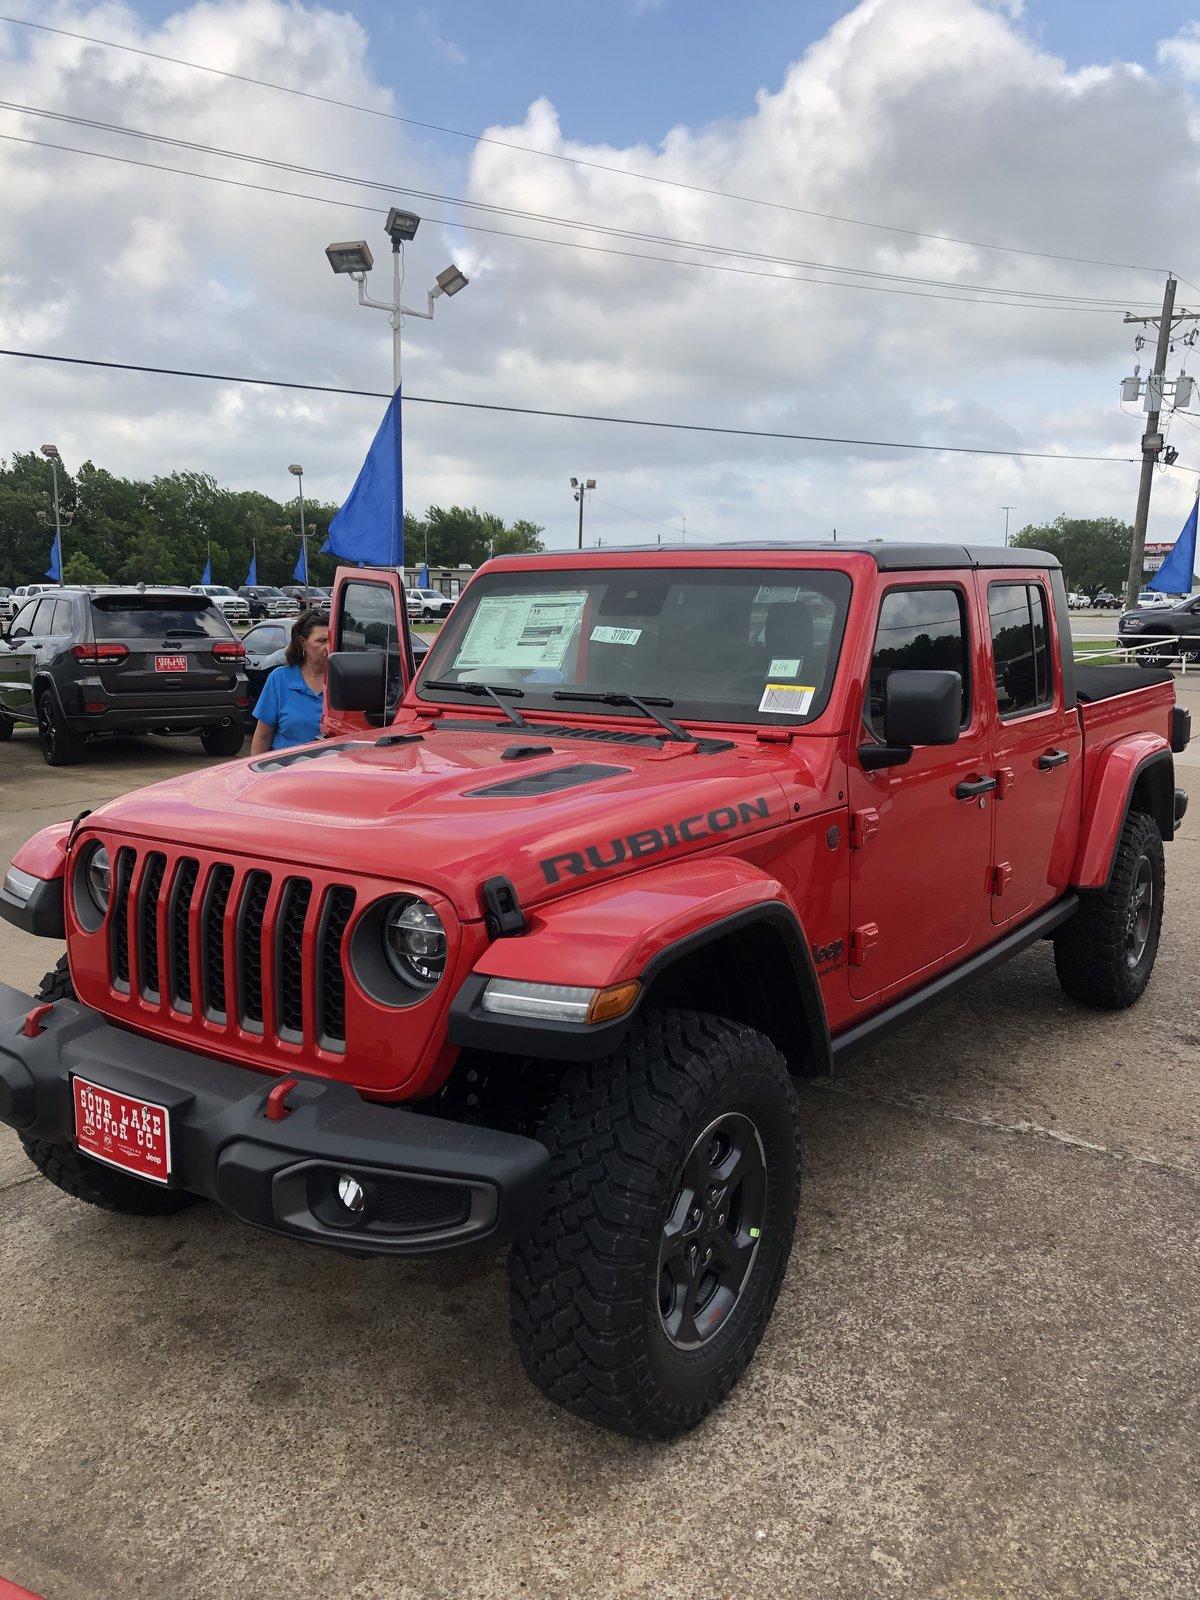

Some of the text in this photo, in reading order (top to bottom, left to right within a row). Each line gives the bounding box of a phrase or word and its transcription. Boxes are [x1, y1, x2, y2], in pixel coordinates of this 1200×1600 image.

[162, 641, 182, 649] Jeep
[540, 797, 770, 885] RUBICON
[81, 1089, 161, 1136] SOUR LAKE
[85, 1109, 157, 1150] MOTOR CO.
[146, 1152, 162, 1165] Jeep
